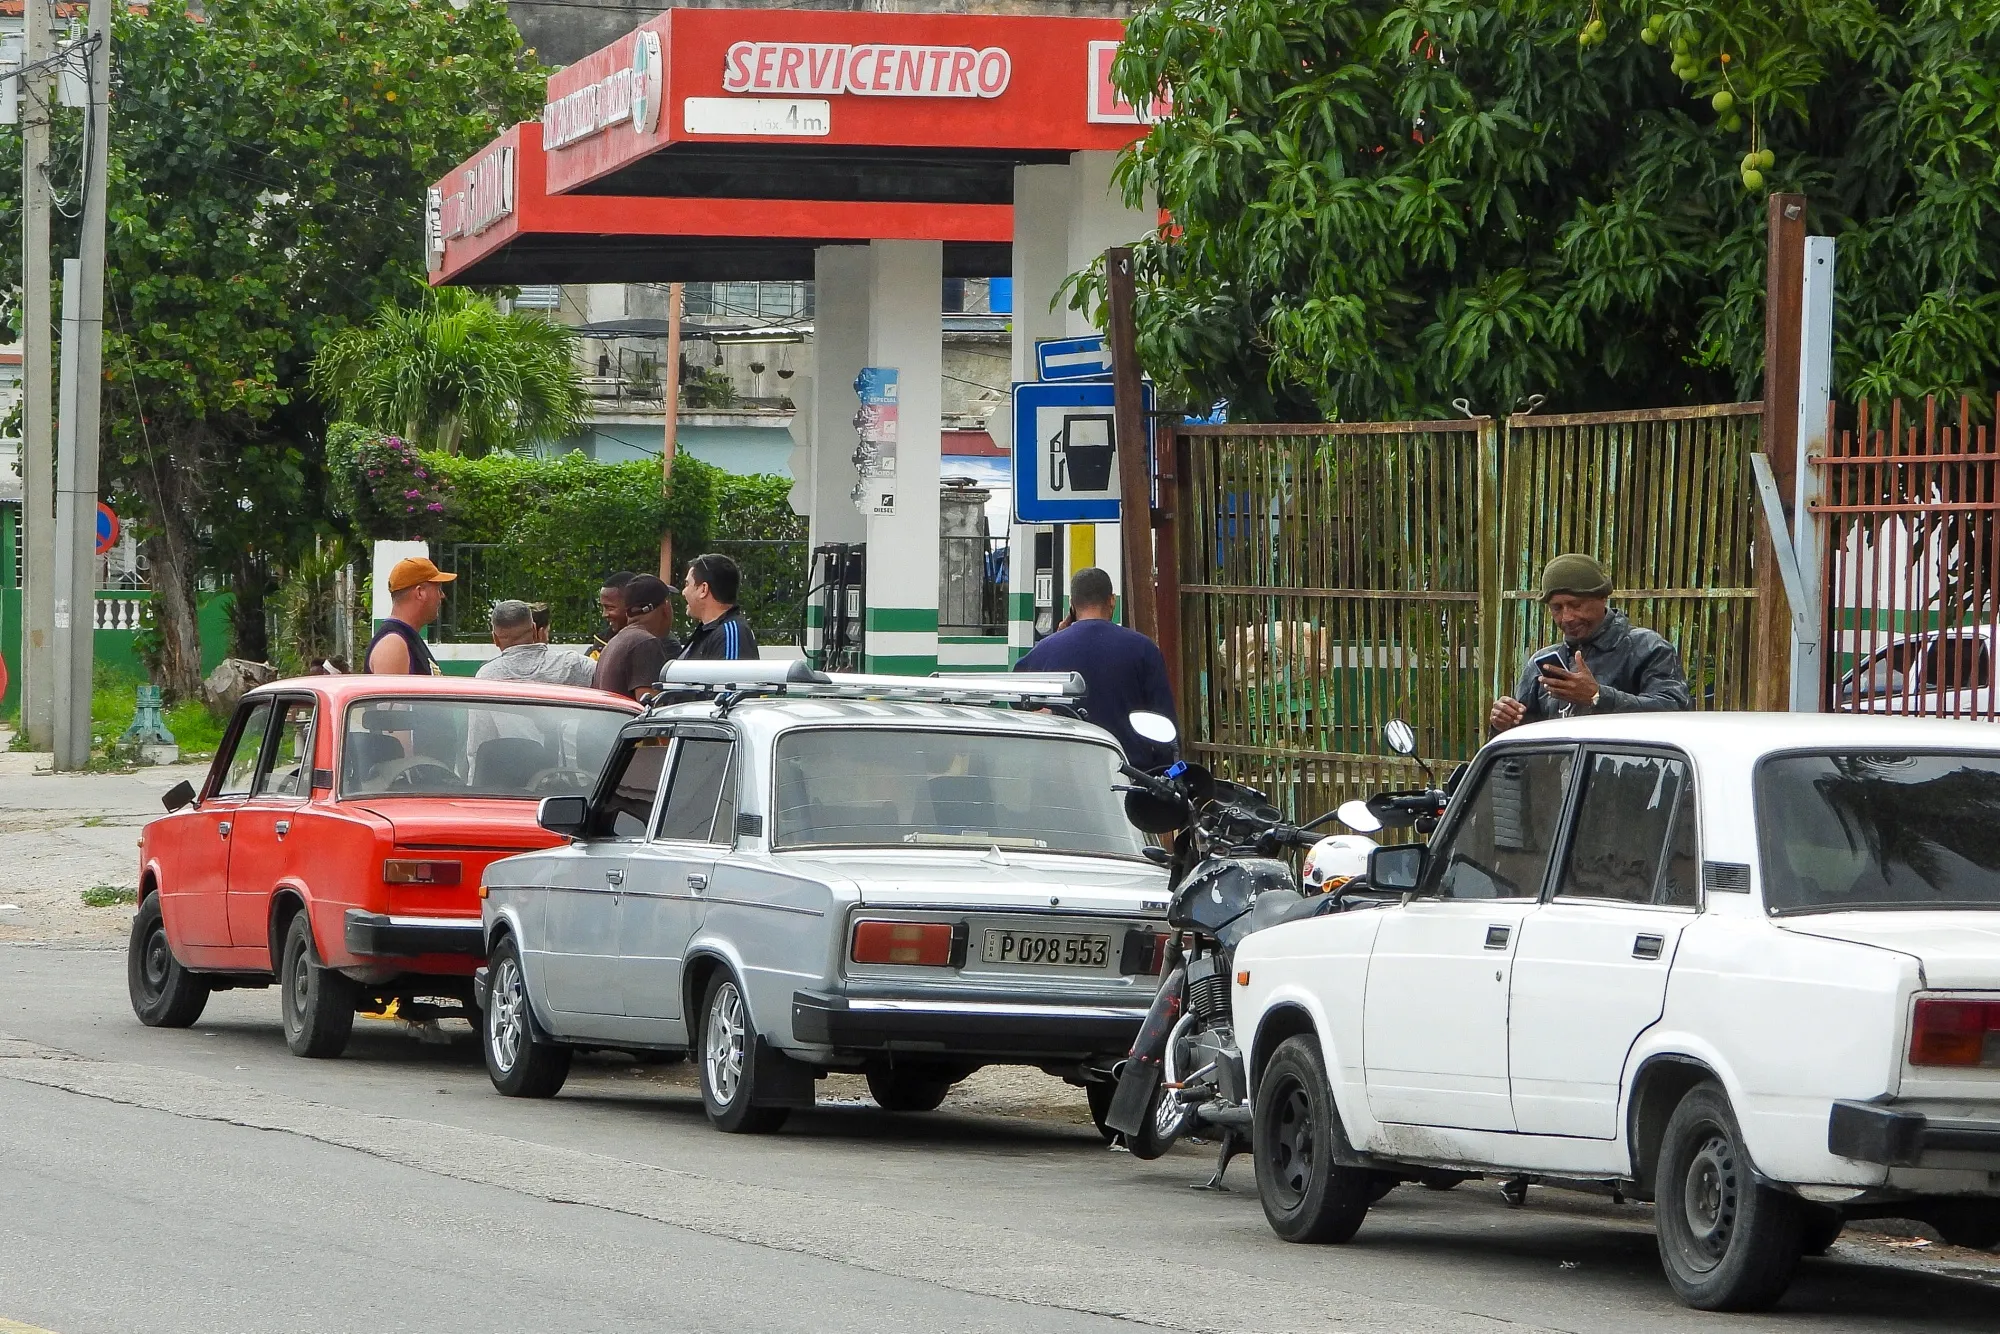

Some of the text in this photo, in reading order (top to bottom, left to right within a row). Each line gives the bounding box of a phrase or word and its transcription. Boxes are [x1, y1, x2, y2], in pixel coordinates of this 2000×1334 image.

[728, 45, 1007, 92] SERVICENTRO
[785, 104, 800, 130] 4
[803, 117, 822, 131] m
[1001, 936, 1107, 965] P 098 553
